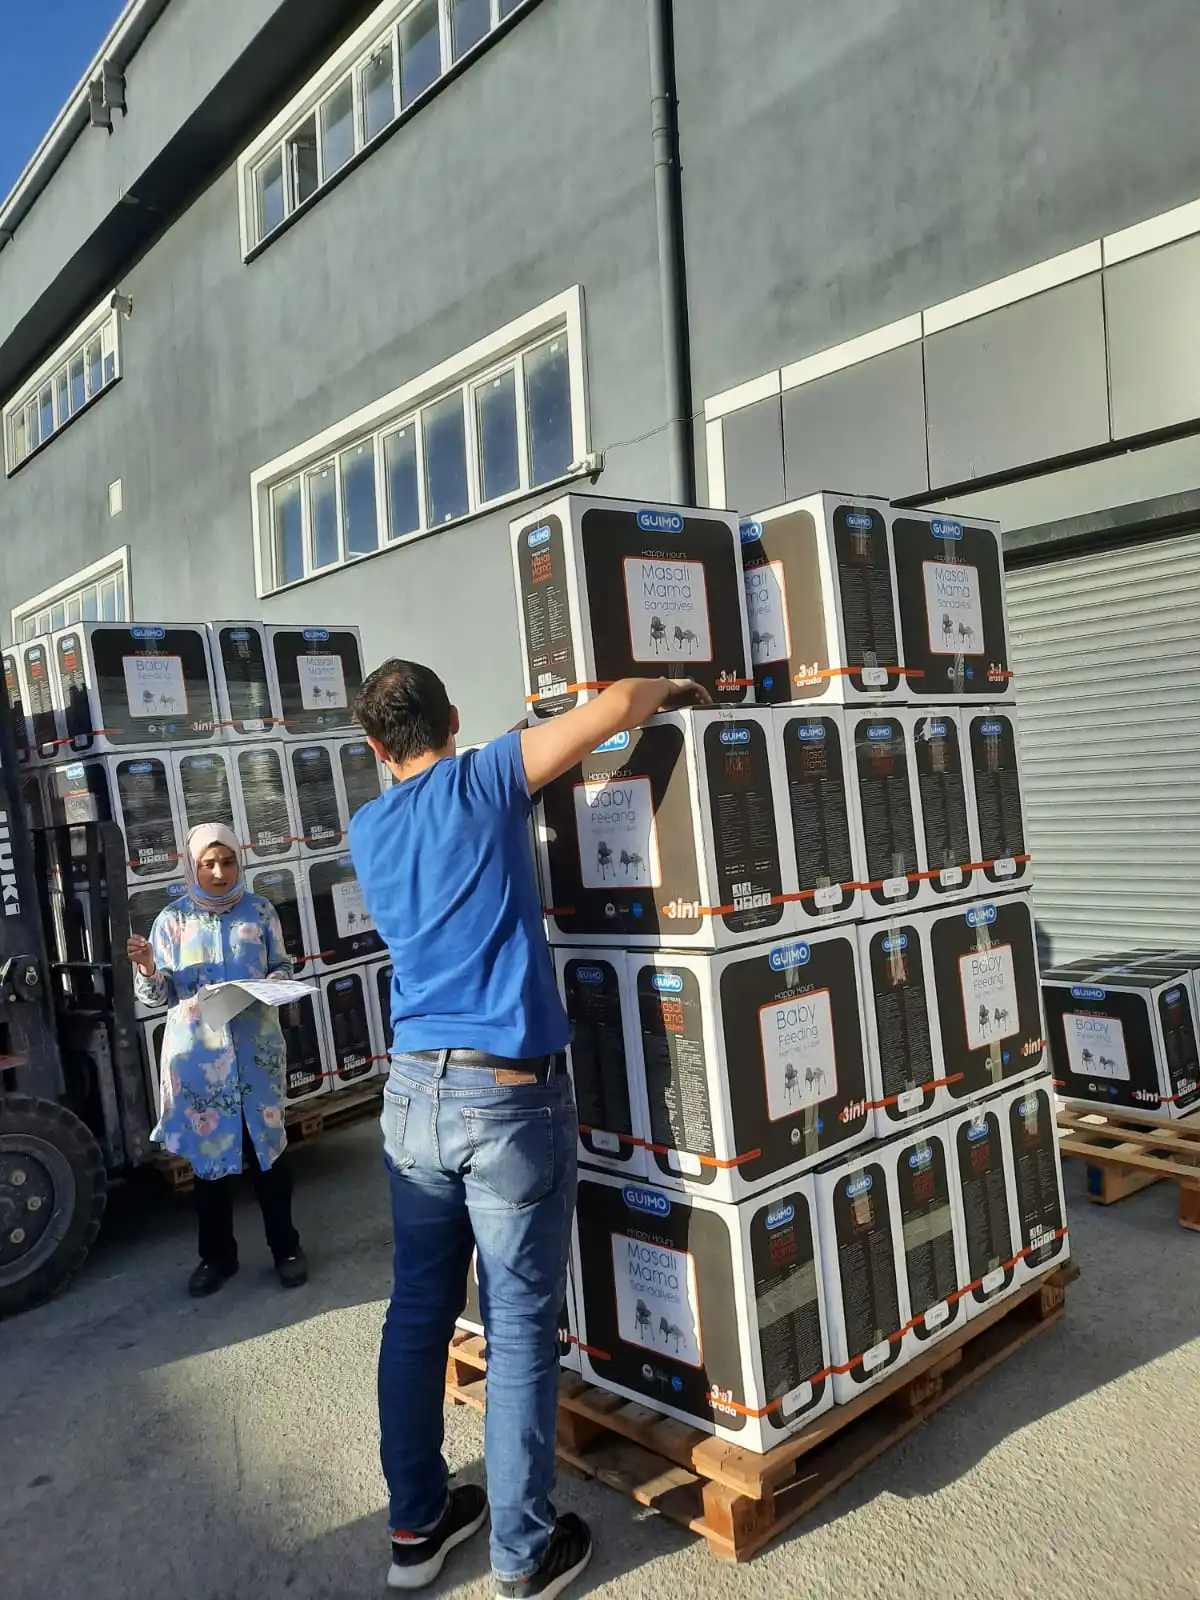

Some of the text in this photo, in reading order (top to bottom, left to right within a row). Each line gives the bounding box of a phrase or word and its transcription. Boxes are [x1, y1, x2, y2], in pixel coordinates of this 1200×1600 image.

[641, 515, 680, 529] GUIMO
[933, 523, 960, 536] GUIMO
[643, 582, 692, 599] Mama
[936, 582, 970, 597] Mama
[133, 628, 163, 637] GUIMO
[136, 660, 169, 672] Baby
[722, 731, 748, 741] GUIMO
[799, 728, 823, 738] GUIMO
[869, 728, 890, 737] GUIMO
[588, 768, 632, 781] Happy Hours
[590, 787, 633, 809] Baby
[591, 810, 636, 824] Feeding
[668, 897, 700, 919] 3in1
[968, 907, 995, 923] GUIMO
[772, 947, 807, 966] GUIMO
[579, 970, 601, 980] GUIMO
[654, 976, 681, 989] GUIMO
[775, 983, 815, 1000] Happy Hours
[1073, 988, 1103, 998] GUIMO
[776, 1003, 816, 1030] Baby
[1075, 1018, 1109, 1034] Baby
[778, 1025, 819, 1048] Feeding
[842, 1098, 865, 1124] 3in1
[848, 1177, 870, 1193] GUIMO
[626, 1190, 667, 1210] GUIMO
[767, 1206, 792, 1224] GUIMO
[628, 1261, 679, 1290] Mama
[708, 1399, 737, 1418] arada
